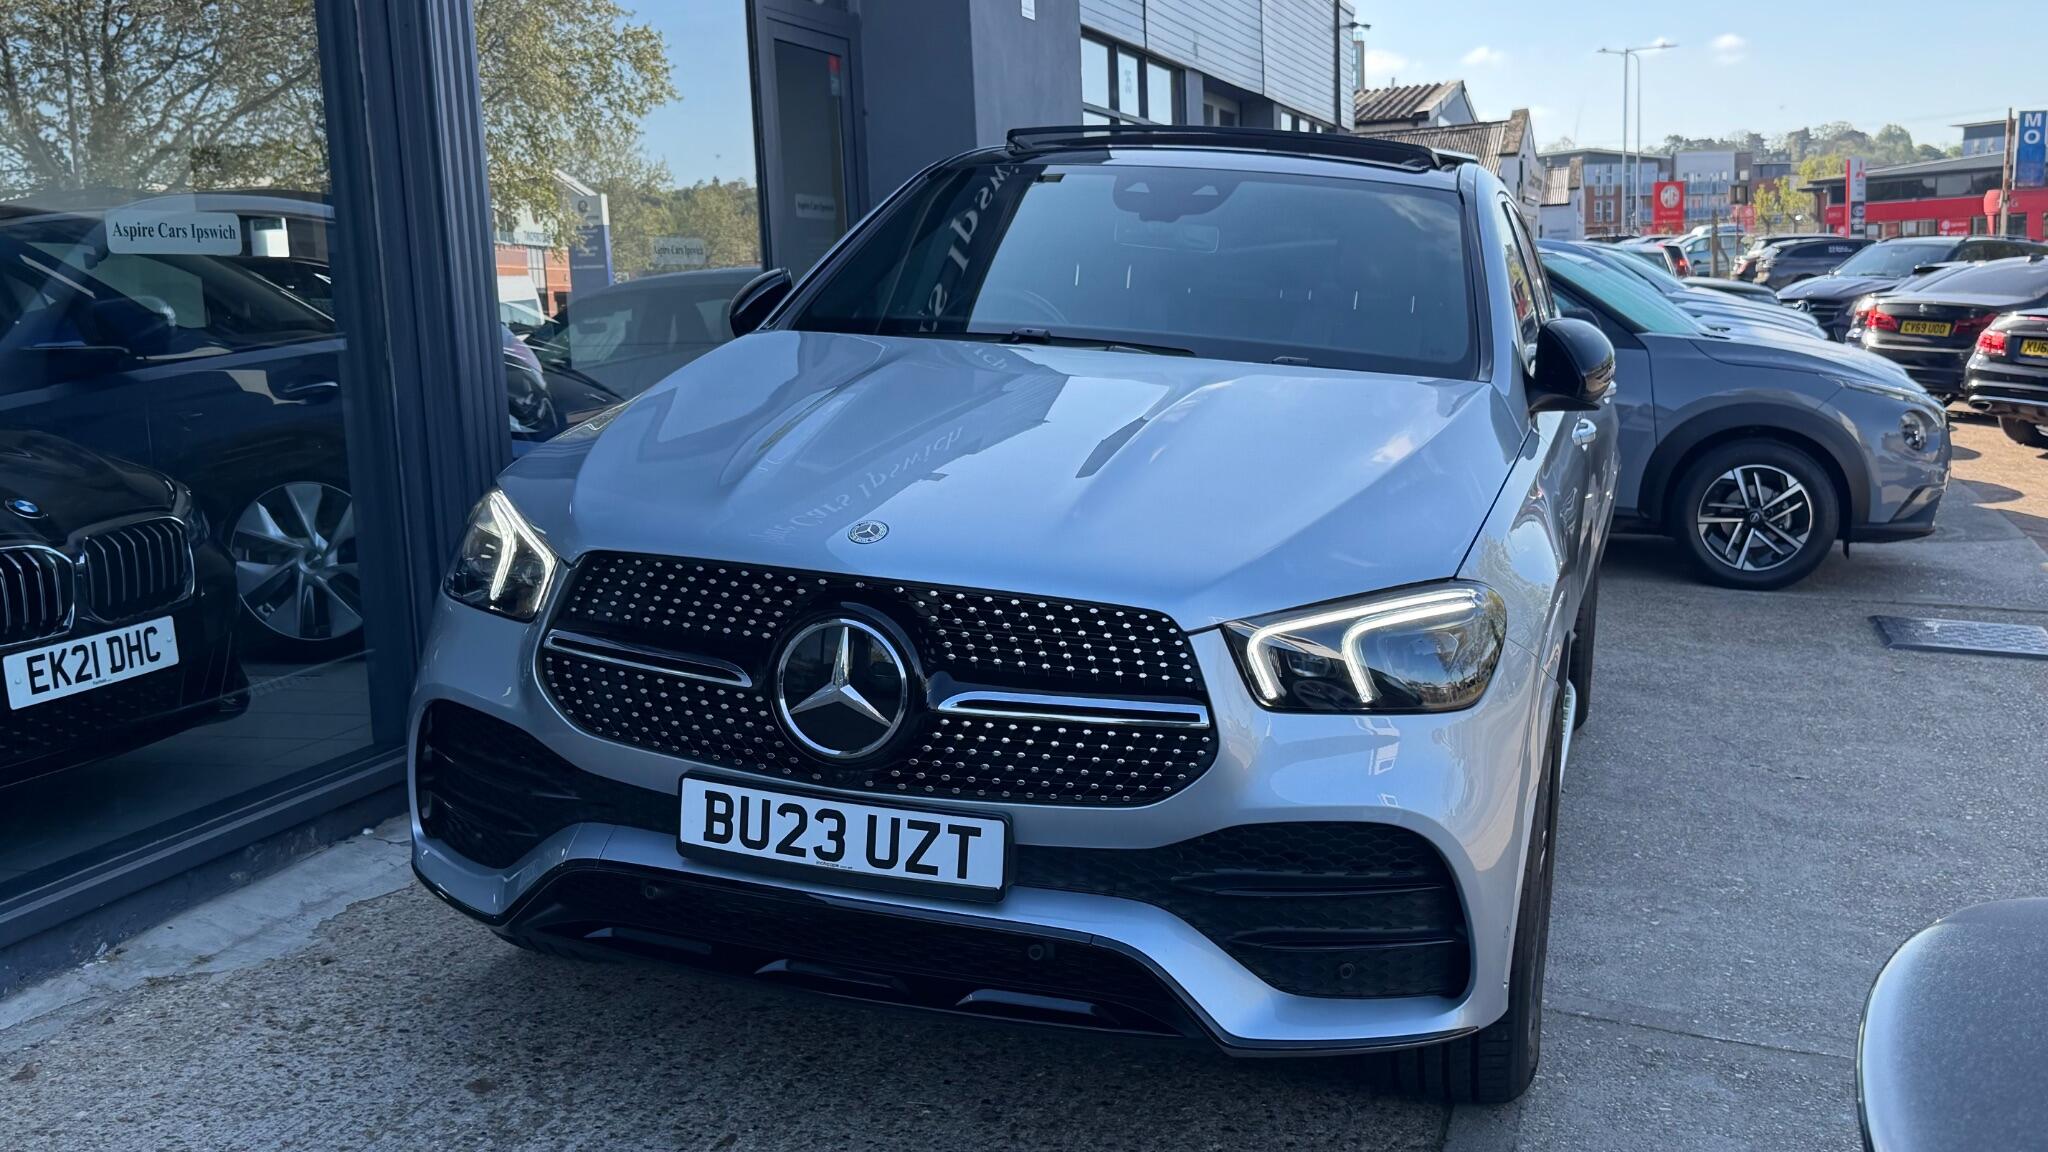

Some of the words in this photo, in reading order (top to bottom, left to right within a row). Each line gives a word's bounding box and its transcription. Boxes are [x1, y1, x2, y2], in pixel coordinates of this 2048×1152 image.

[113, 221, 154, 241] Aspire
[158, 222, 188, 239] Cars
[191, 223, 236, 243] Ipswich
[26, 641, 101, 695] EK21
[107, 626, 161, 674] DHC
[703, 789, 847, 862] BU23
[866, 813, 982, 880] UZT
